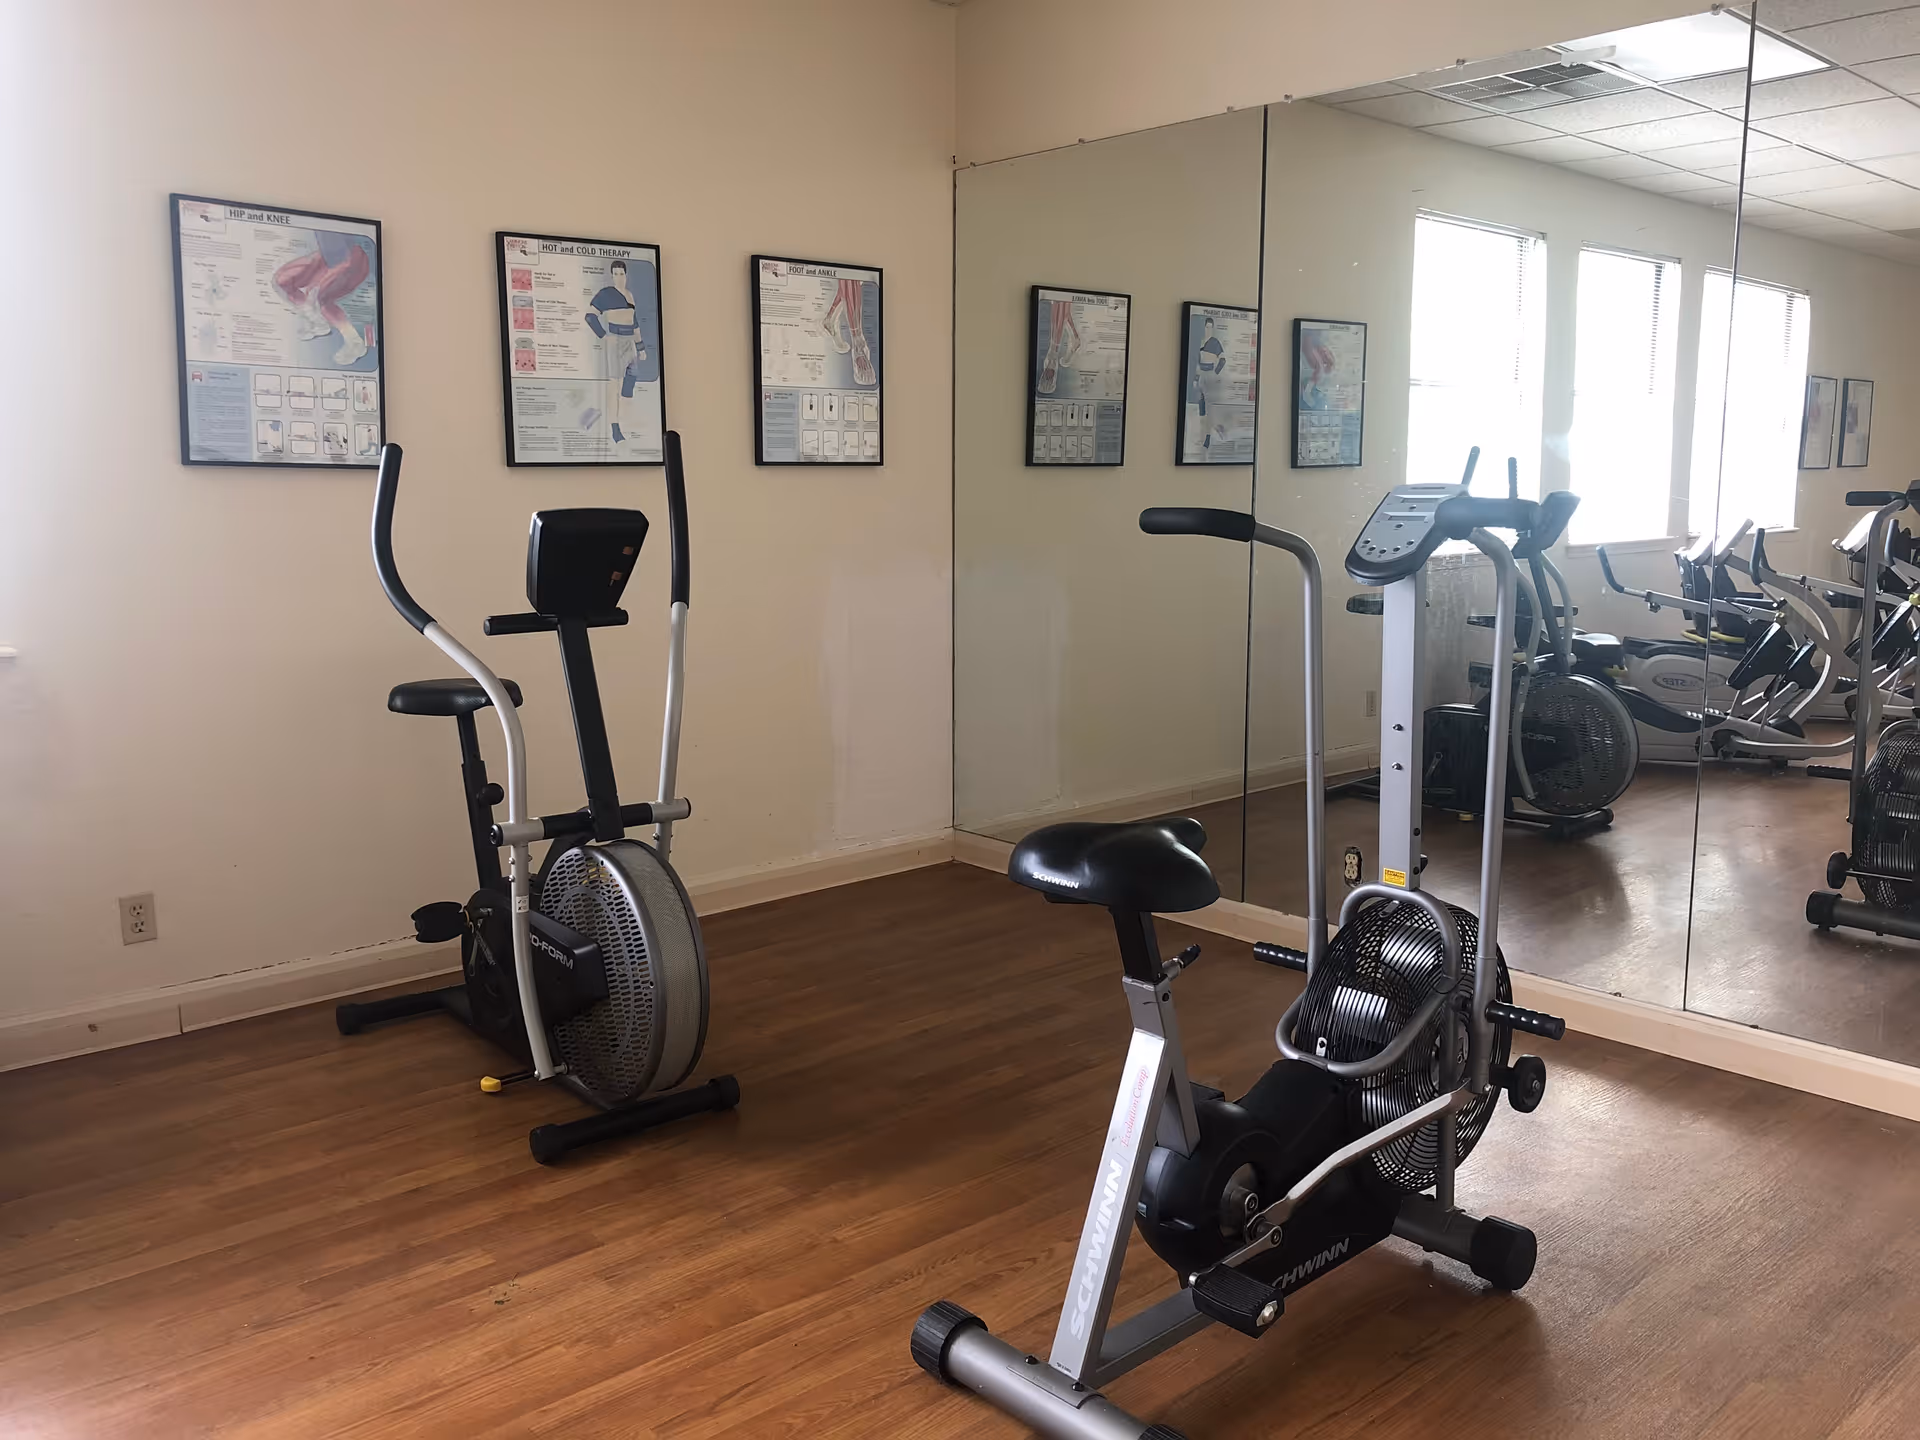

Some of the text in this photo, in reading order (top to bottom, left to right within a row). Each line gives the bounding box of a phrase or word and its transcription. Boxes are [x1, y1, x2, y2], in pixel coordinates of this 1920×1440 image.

[229, 208, 246, 219] HIP
[247, 211, 264, 221] and
[266, 214, 291, 225] KNEE
[542, 243, 558, 252] HOT
[560, 245, 574, 253] and
[576, 247, 596, 256] COLD
[599, 248, 631, 258] THERAPY
[789, 266, 804, 274] FOOT
[817, 269, 837, 277] ANKLE
[1032, 871, 1079, 889] SCHWINN
[529, 932, 574, 970] O-FORM
[1070, 1068, 1150, 1341] SCHWINN Evolution Comp
[1271, 1237, 1350, 1289] CHWINN
